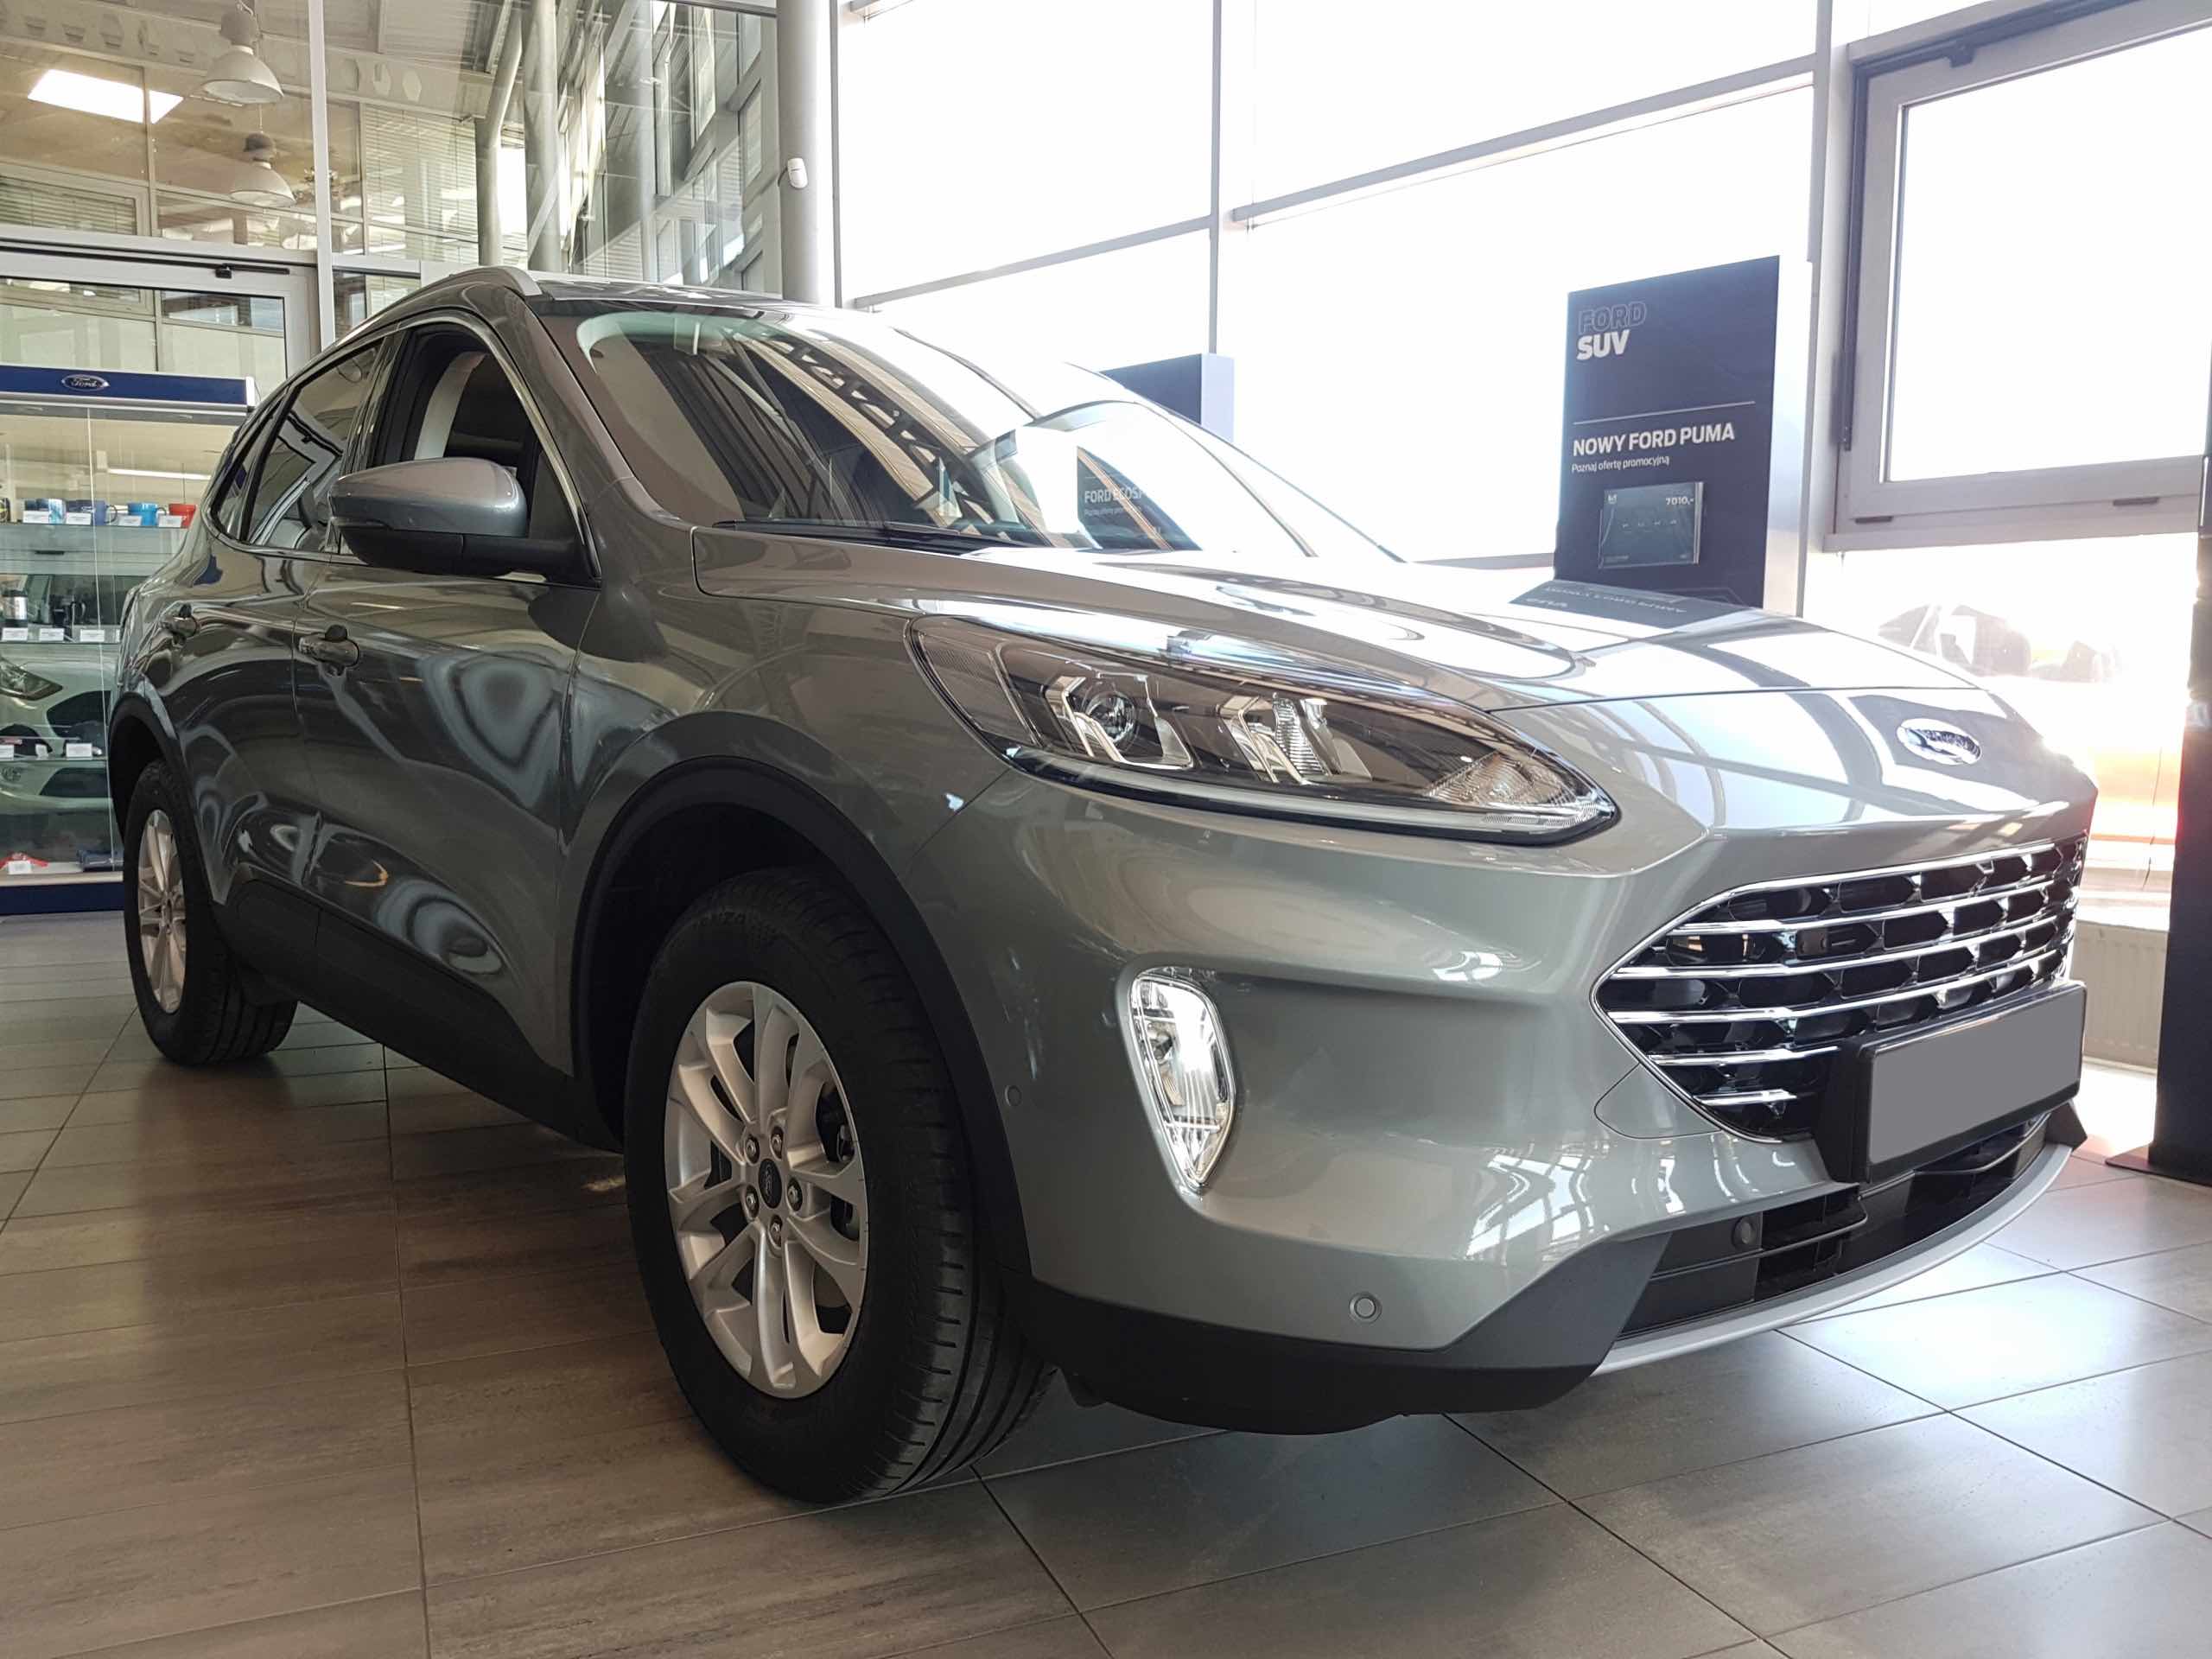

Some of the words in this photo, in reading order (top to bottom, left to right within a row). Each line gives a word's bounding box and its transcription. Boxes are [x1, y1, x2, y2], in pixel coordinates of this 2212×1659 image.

[1578, 301, 1647, 335] FORD
[1576, 328, 1630, 360] SUV
[1573, 434, 1625, 456] NOWY
[1629, 429, 1676, 450] FORD
[1680, 423, 1735, 445] PUMA
[1572, 461, 1597, 473] Poznaj
[1084, 489, 1112, 504] FORD
[1113, 486, 1141, 501] ECOS
